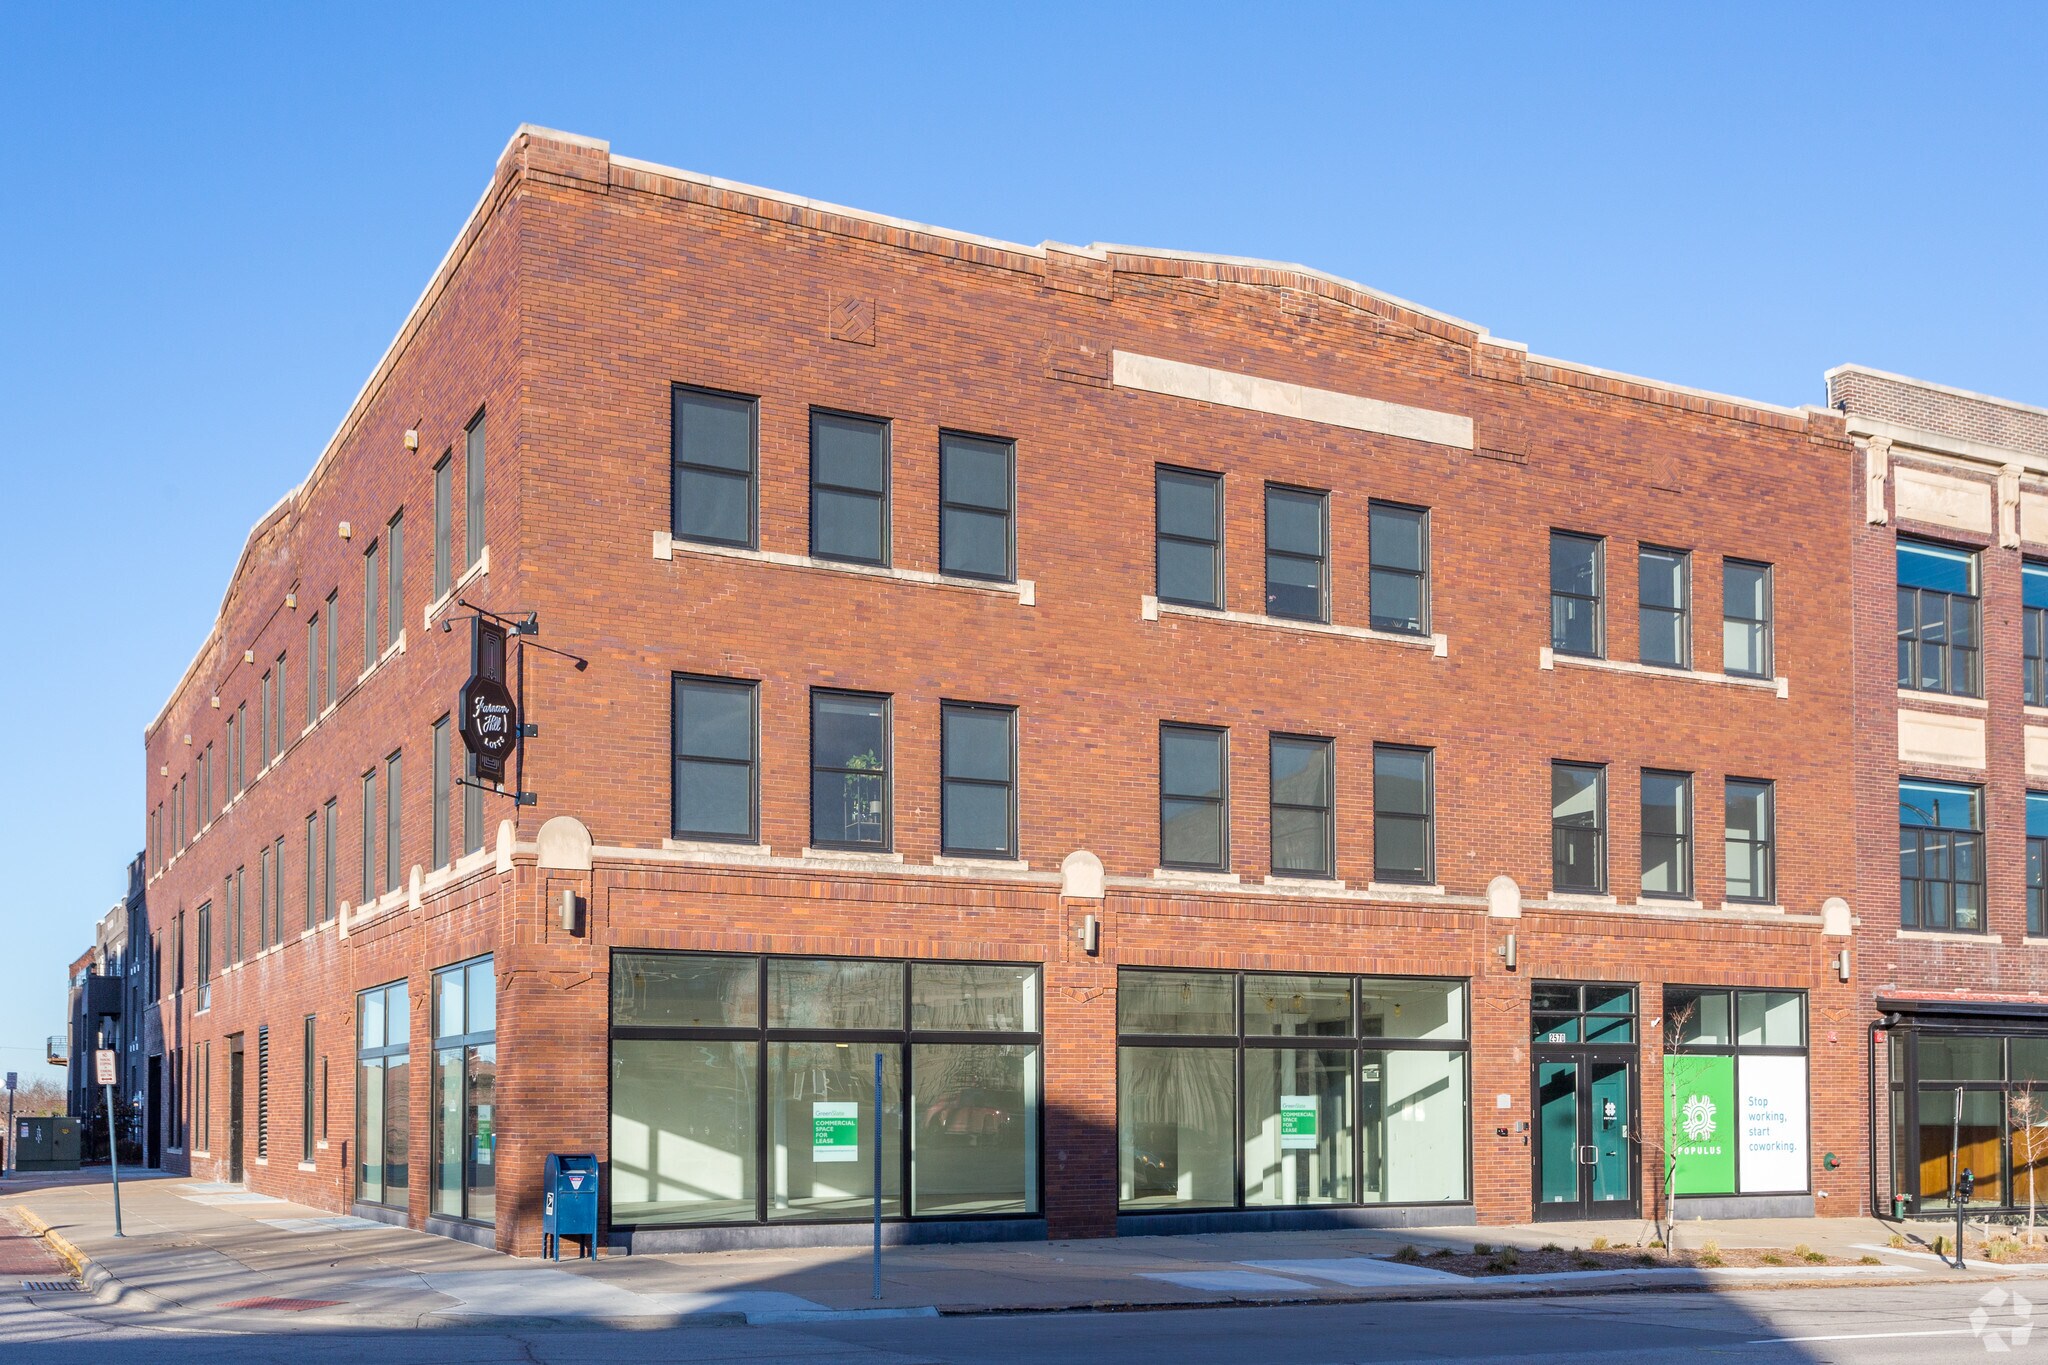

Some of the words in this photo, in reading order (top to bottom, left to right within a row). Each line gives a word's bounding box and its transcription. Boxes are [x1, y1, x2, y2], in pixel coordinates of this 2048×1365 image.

[483, 714, 501, 732] Hill
[484, 736, 505, 749] LOFTS
[1748, 1096, 1768, 1108] Stop
[1748, 1111, 1787, 1123] working,
[1748, 1127, 1770, 1136] start
[1677, 1146, 1722, 1155] POPULUS
[1748, 1141, 1797, 1153] coworking.
